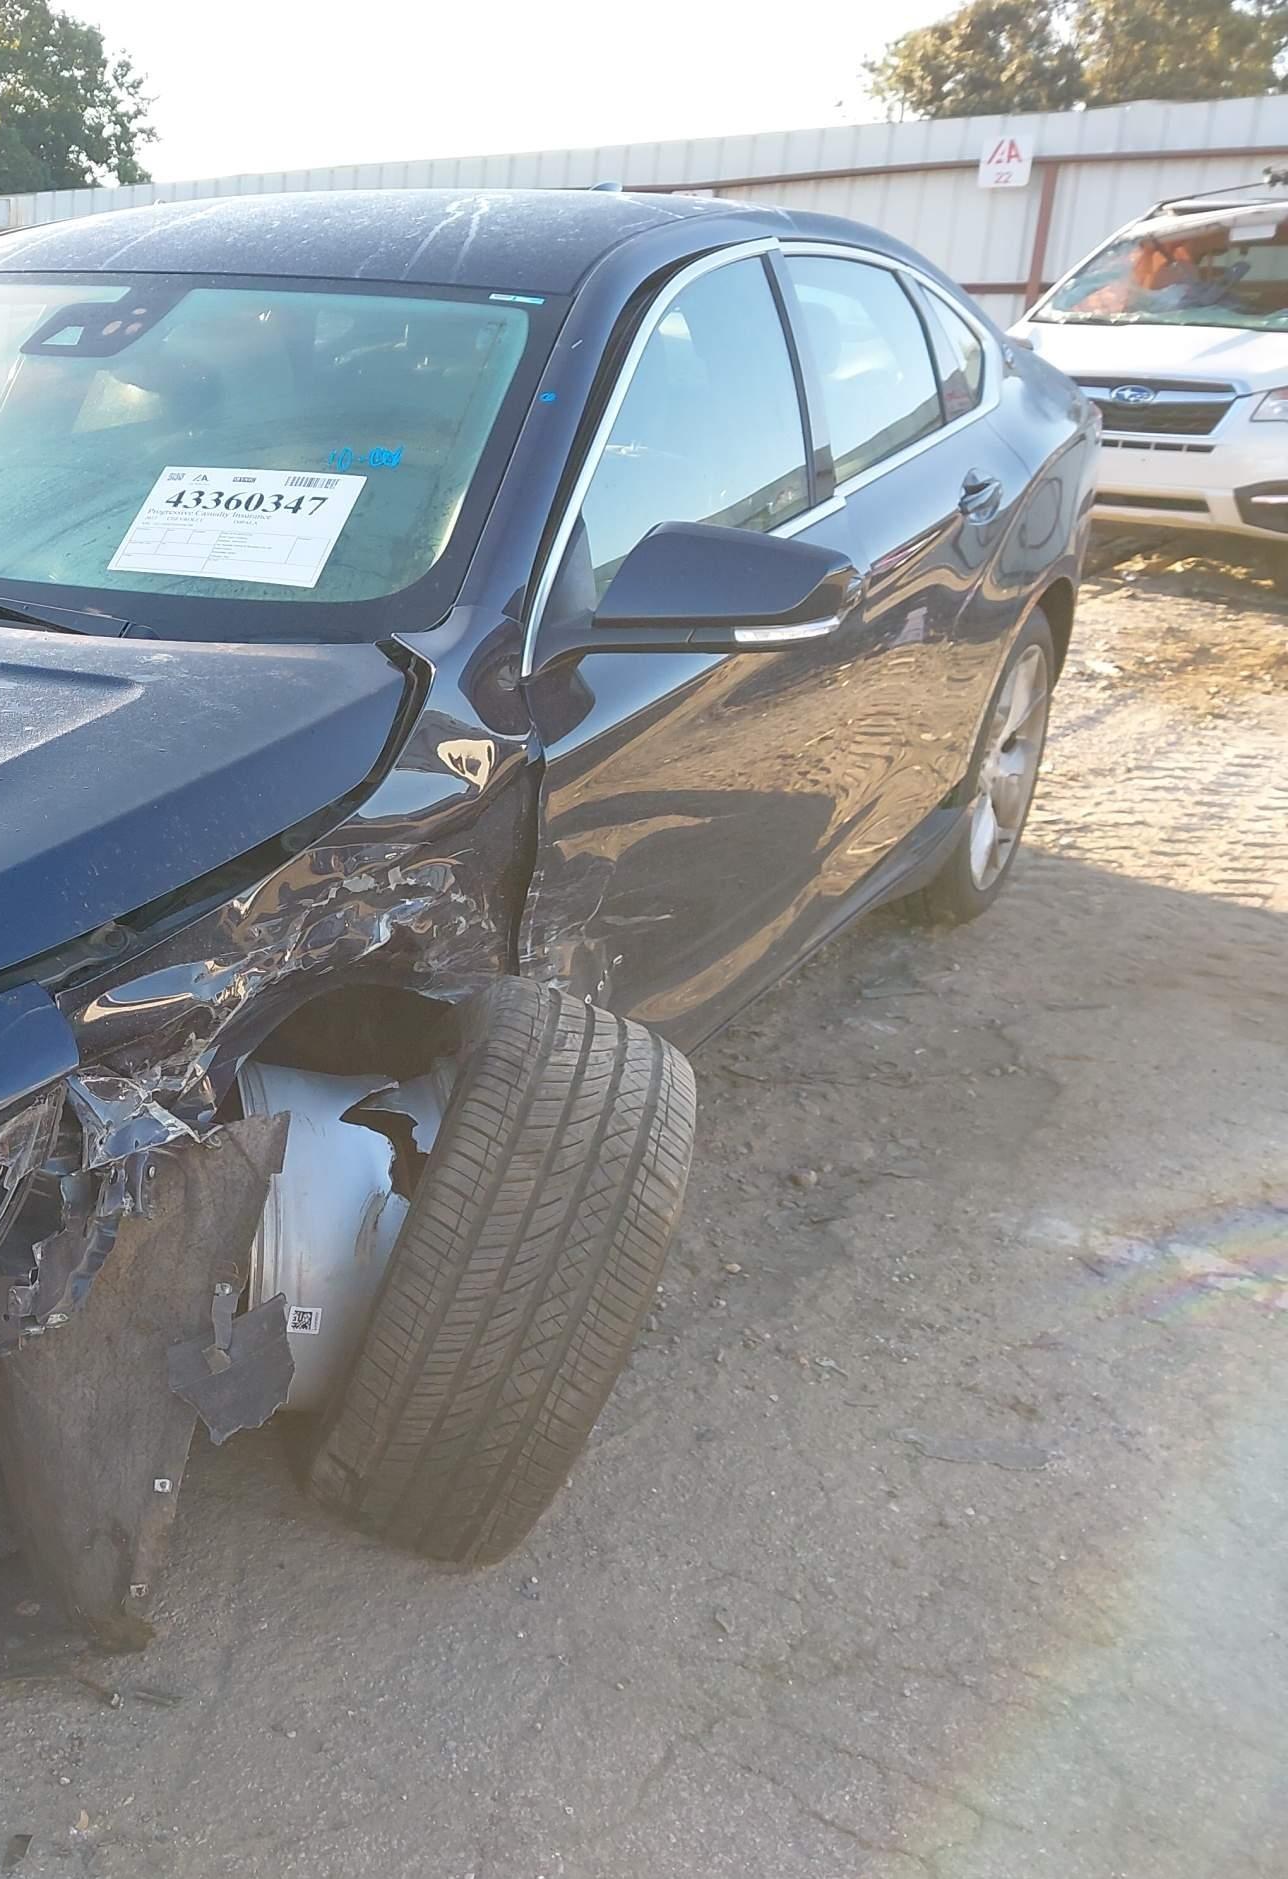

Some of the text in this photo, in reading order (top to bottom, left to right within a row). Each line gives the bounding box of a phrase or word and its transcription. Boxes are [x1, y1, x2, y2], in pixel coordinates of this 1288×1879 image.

[994, 171, 1014, 184] 22
[165, 489, 329, 516] 43360347
[147, 508, 272, 520] Progressive Casualty Insurance
